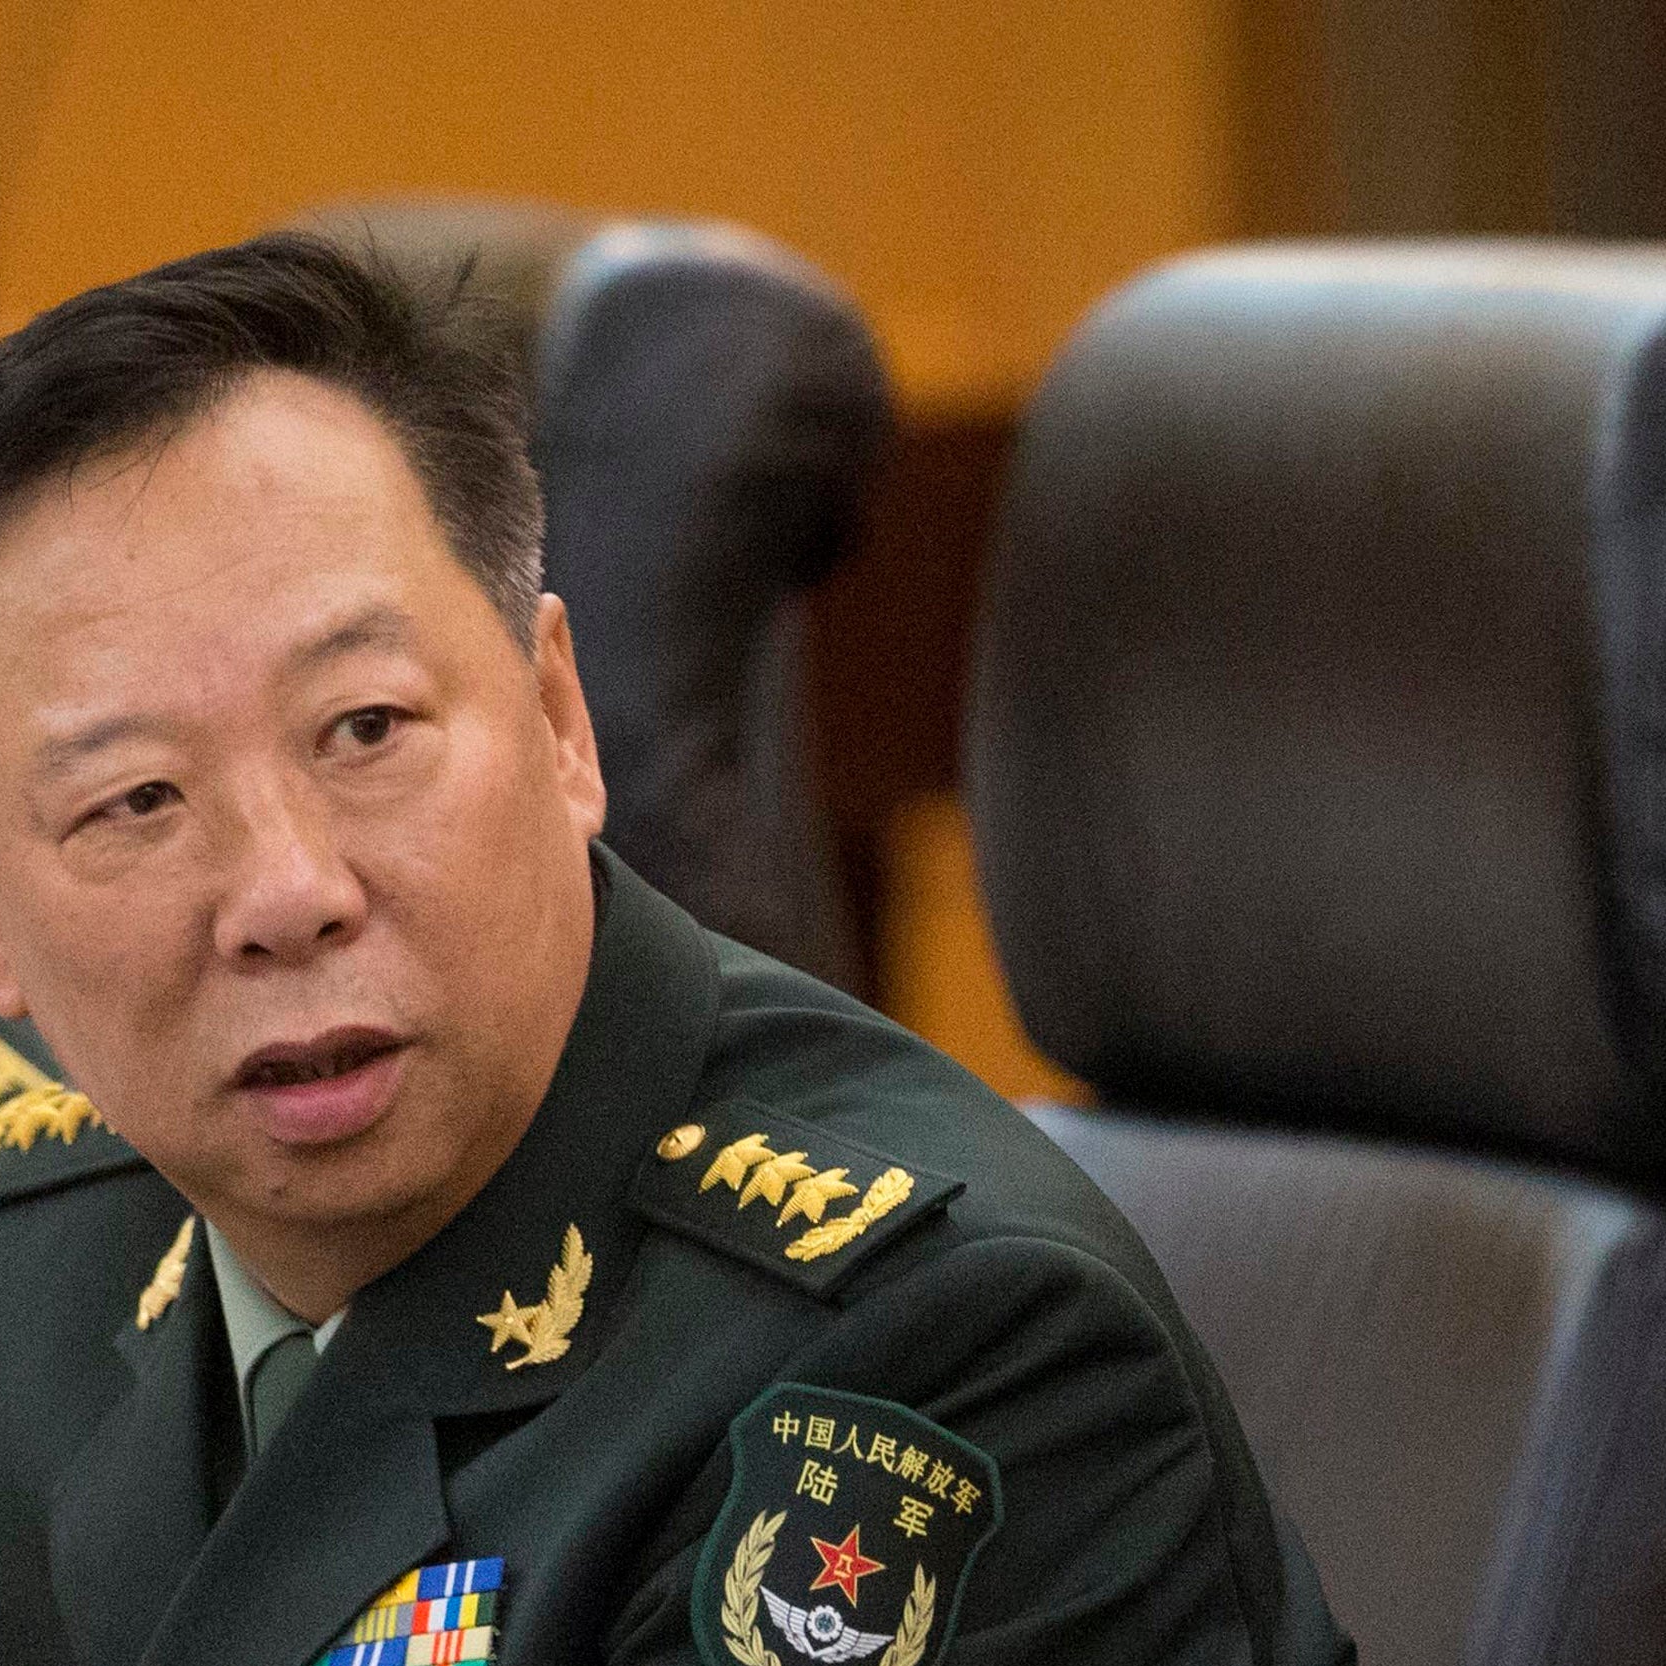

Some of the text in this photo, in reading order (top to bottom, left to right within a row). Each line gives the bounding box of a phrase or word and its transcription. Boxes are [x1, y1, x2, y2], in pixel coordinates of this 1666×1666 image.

[772, 1410, 981, 1515] 中国人民解放军
